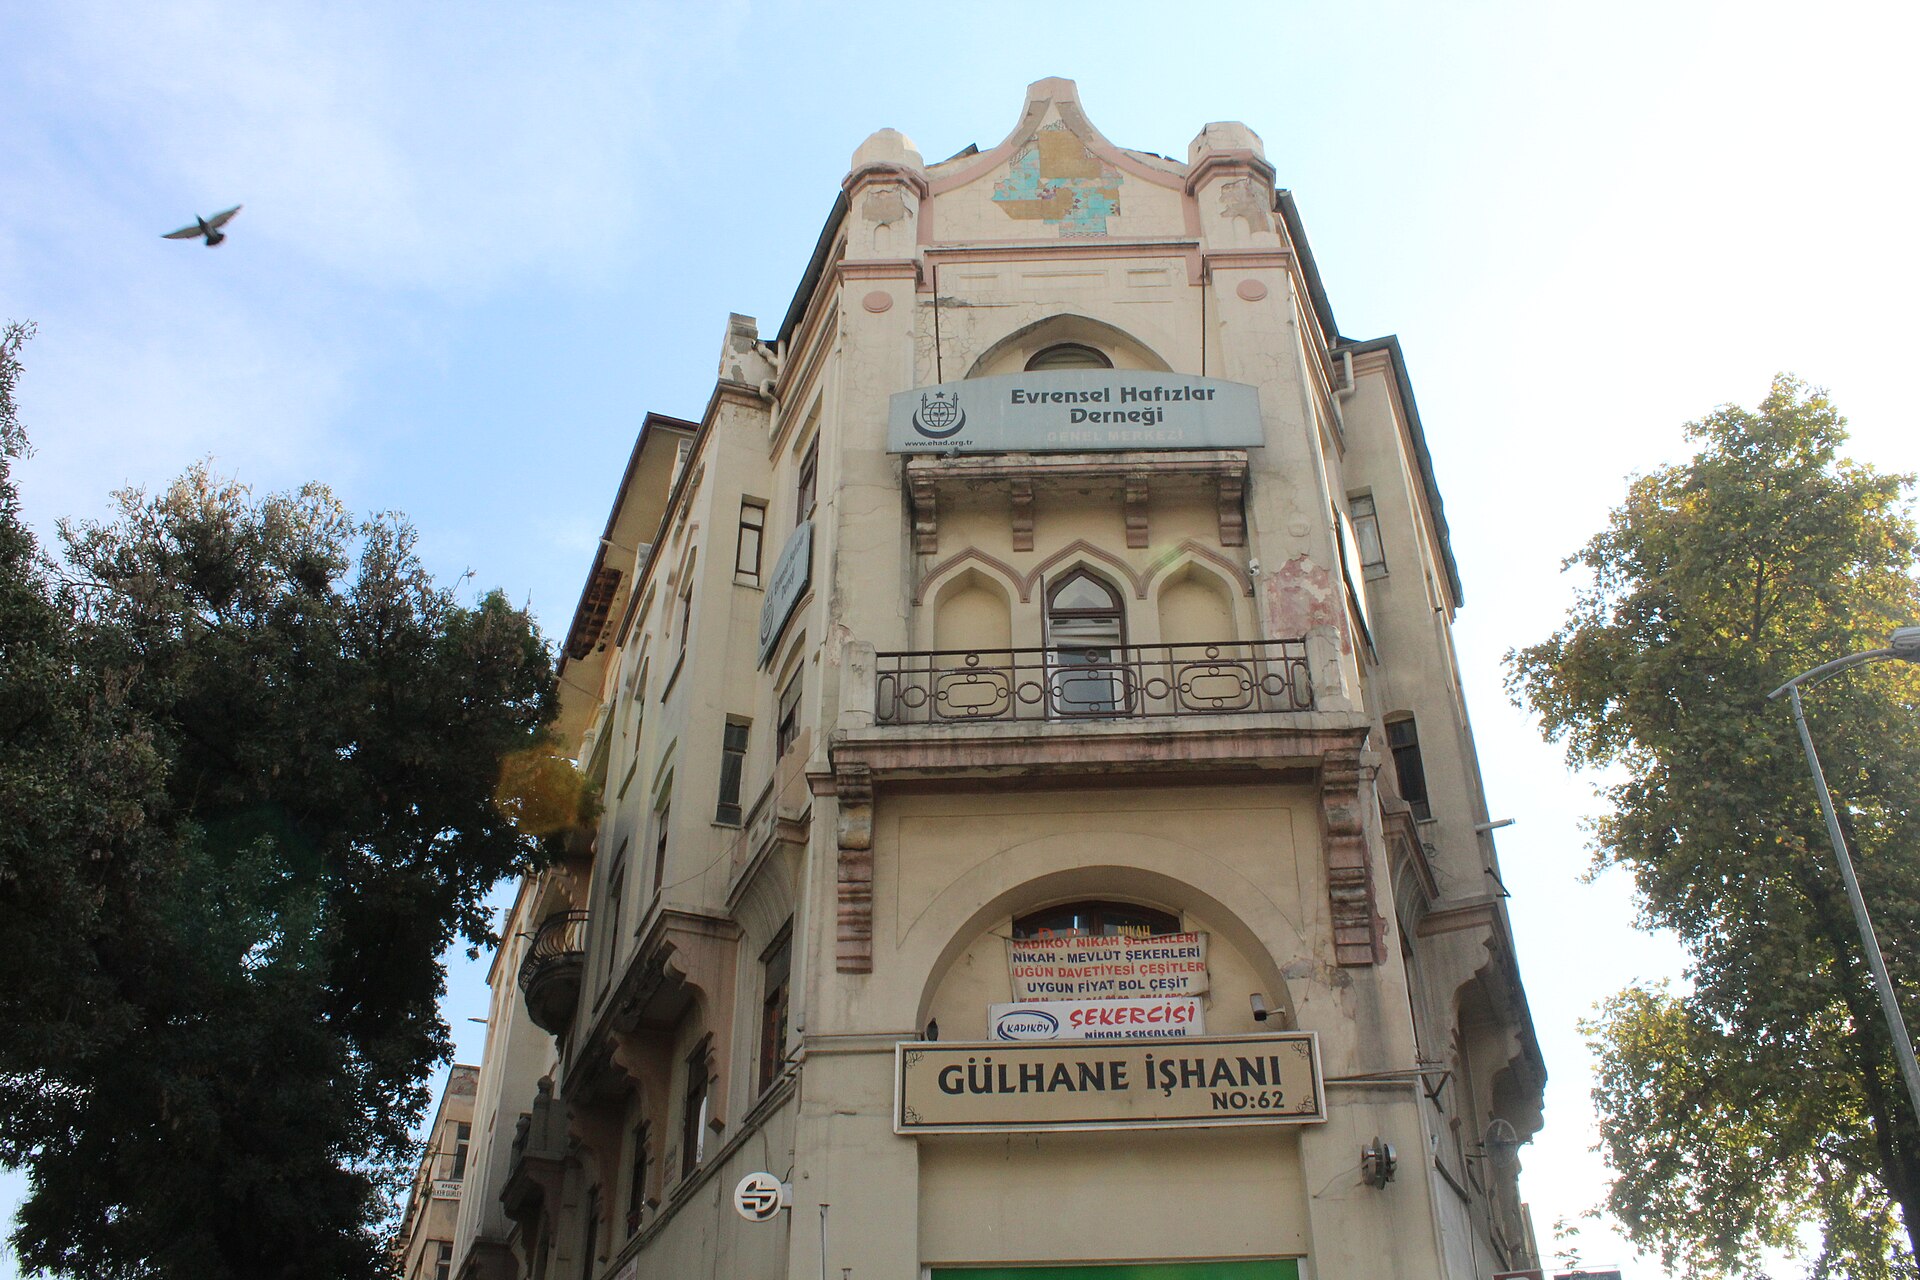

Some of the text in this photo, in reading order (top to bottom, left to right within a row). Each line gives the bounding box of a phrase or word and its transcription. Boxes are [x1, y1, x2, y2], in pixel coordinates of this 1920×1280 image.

[1010, 386, 1216, 404] Evrensel Hafızlar
[1070, 407, 1163, 426] Derneği
[1046, 431, 1101, 442] GENEL
[1076, 935, 1119, 947] NİKAH
[1013, 951, 1056, 962] NİKAH
[1067, 949, 1121, 963] MEVLÜT
[1126, 946, 1200, 962] ŞEKERLERİ
[1012, 961, 1206, 978] ÜĞÜN DAVETİYESİ ÇEŞİTLER
[1027, 976, 1189, 993] UYGUN FİYAT BOL ÇEŞİT
[1069, 1001, 1196, 1029] ŞEKERCİSİ
[1006, 1021, 1050, 1033] KADIKÖY
[1085, 1030, 1122, 1039] NİKAH
[938, 1053, 1282, 1097] GÜLHANE İŞHANI
[1210, 1090, 1285, 1110] NO:62
